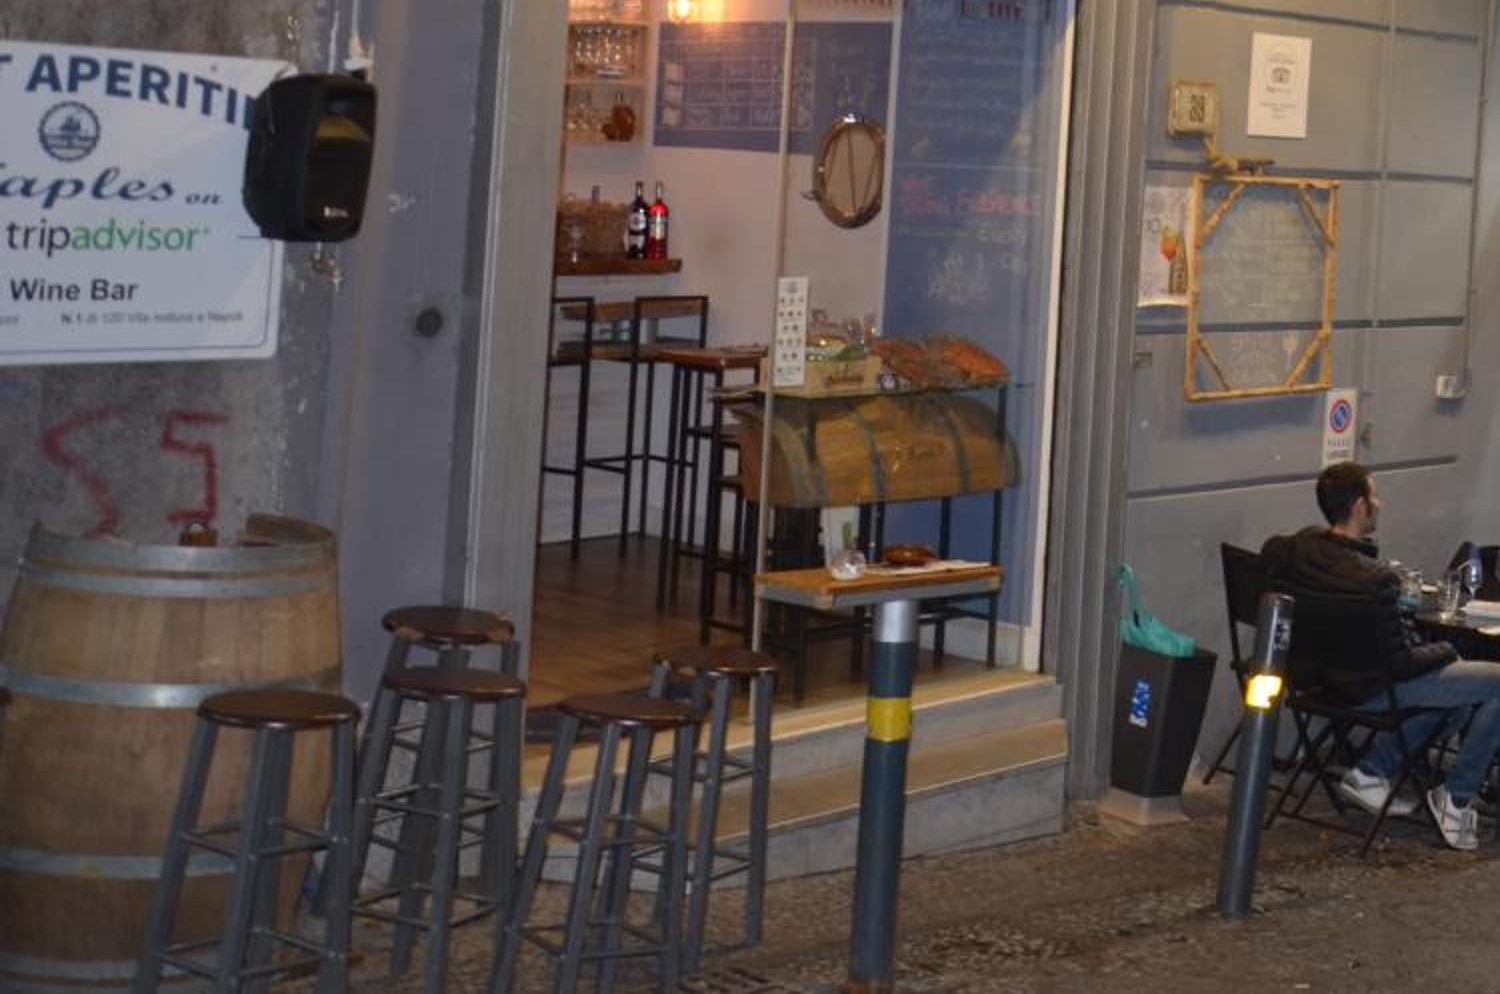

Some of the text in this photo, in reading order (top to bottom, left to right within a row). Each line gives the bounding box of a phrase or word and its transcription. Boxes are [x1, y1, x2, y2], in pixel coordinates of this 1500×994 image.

[0, 163, 174, 209] aples
[6, 218, 200, 259] tripadvisor
[10, 278, 139, 302] Wine Bar
